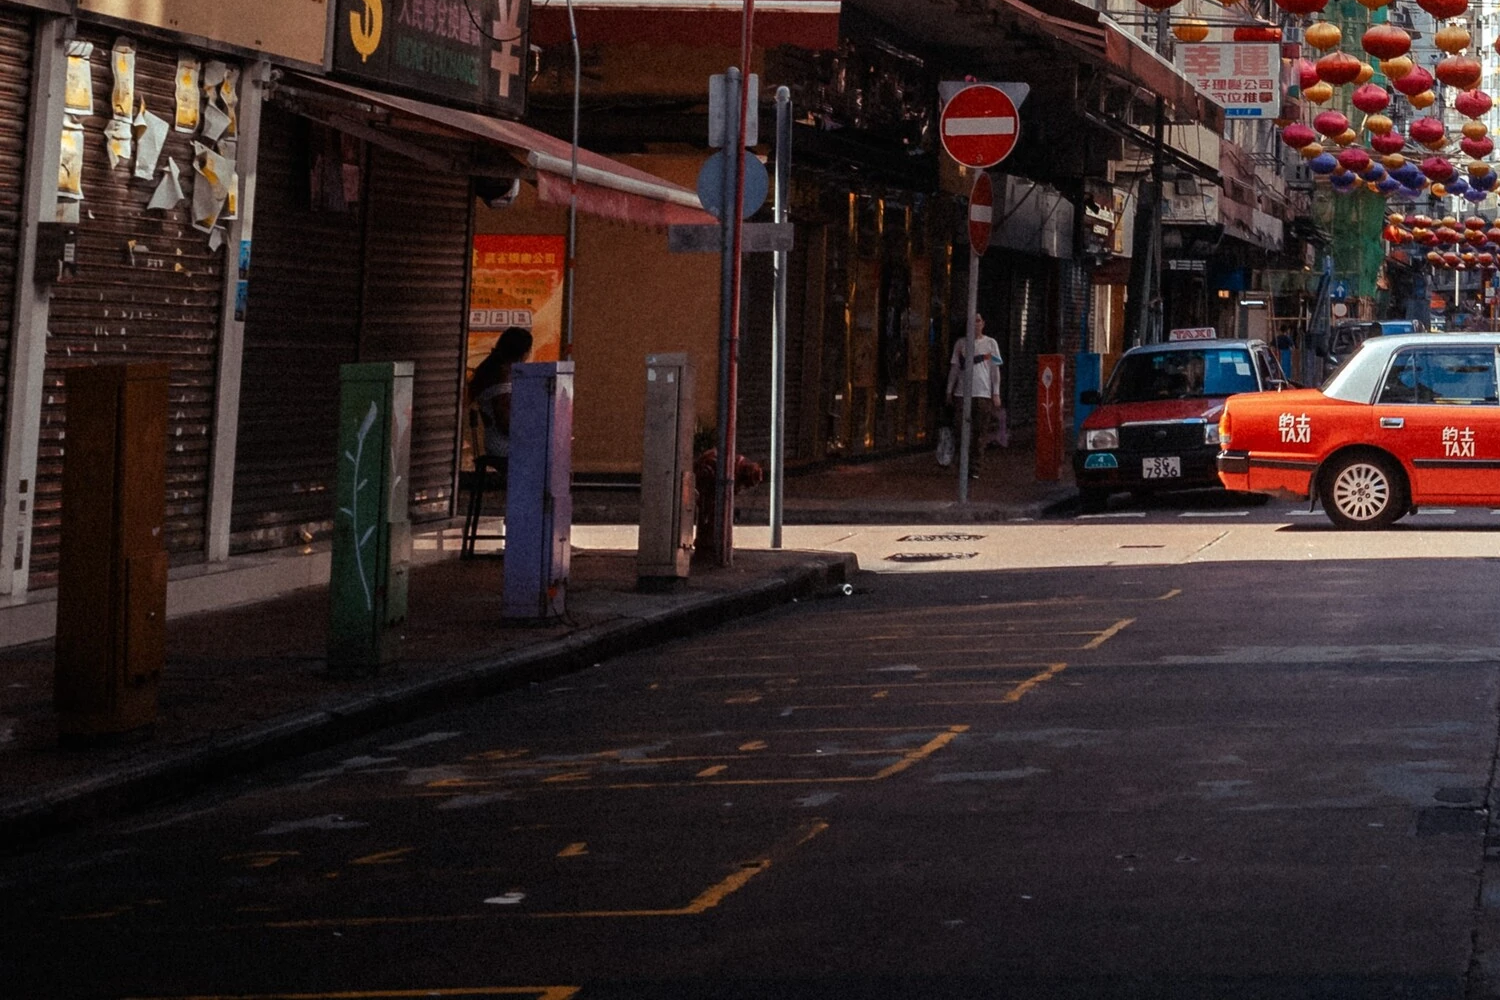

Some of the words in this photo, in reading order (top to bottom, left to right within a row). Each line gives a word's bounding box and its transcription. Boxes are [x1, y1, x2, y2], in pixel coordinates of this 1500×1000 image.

[1184, 45, 1270, 77] 幸運
[1174, 328, 1213, 339] TAXI
[1279, 412, 1311, 428] 的士
[1280, 427, 1311, 443] TAXI
[1442, 426, 1476, 442] 的士
[1442, 441, 1475, 457] TAXI
[1153, 457, 1170, 469] SG
[1145, 467, 1178, 479] 7936
